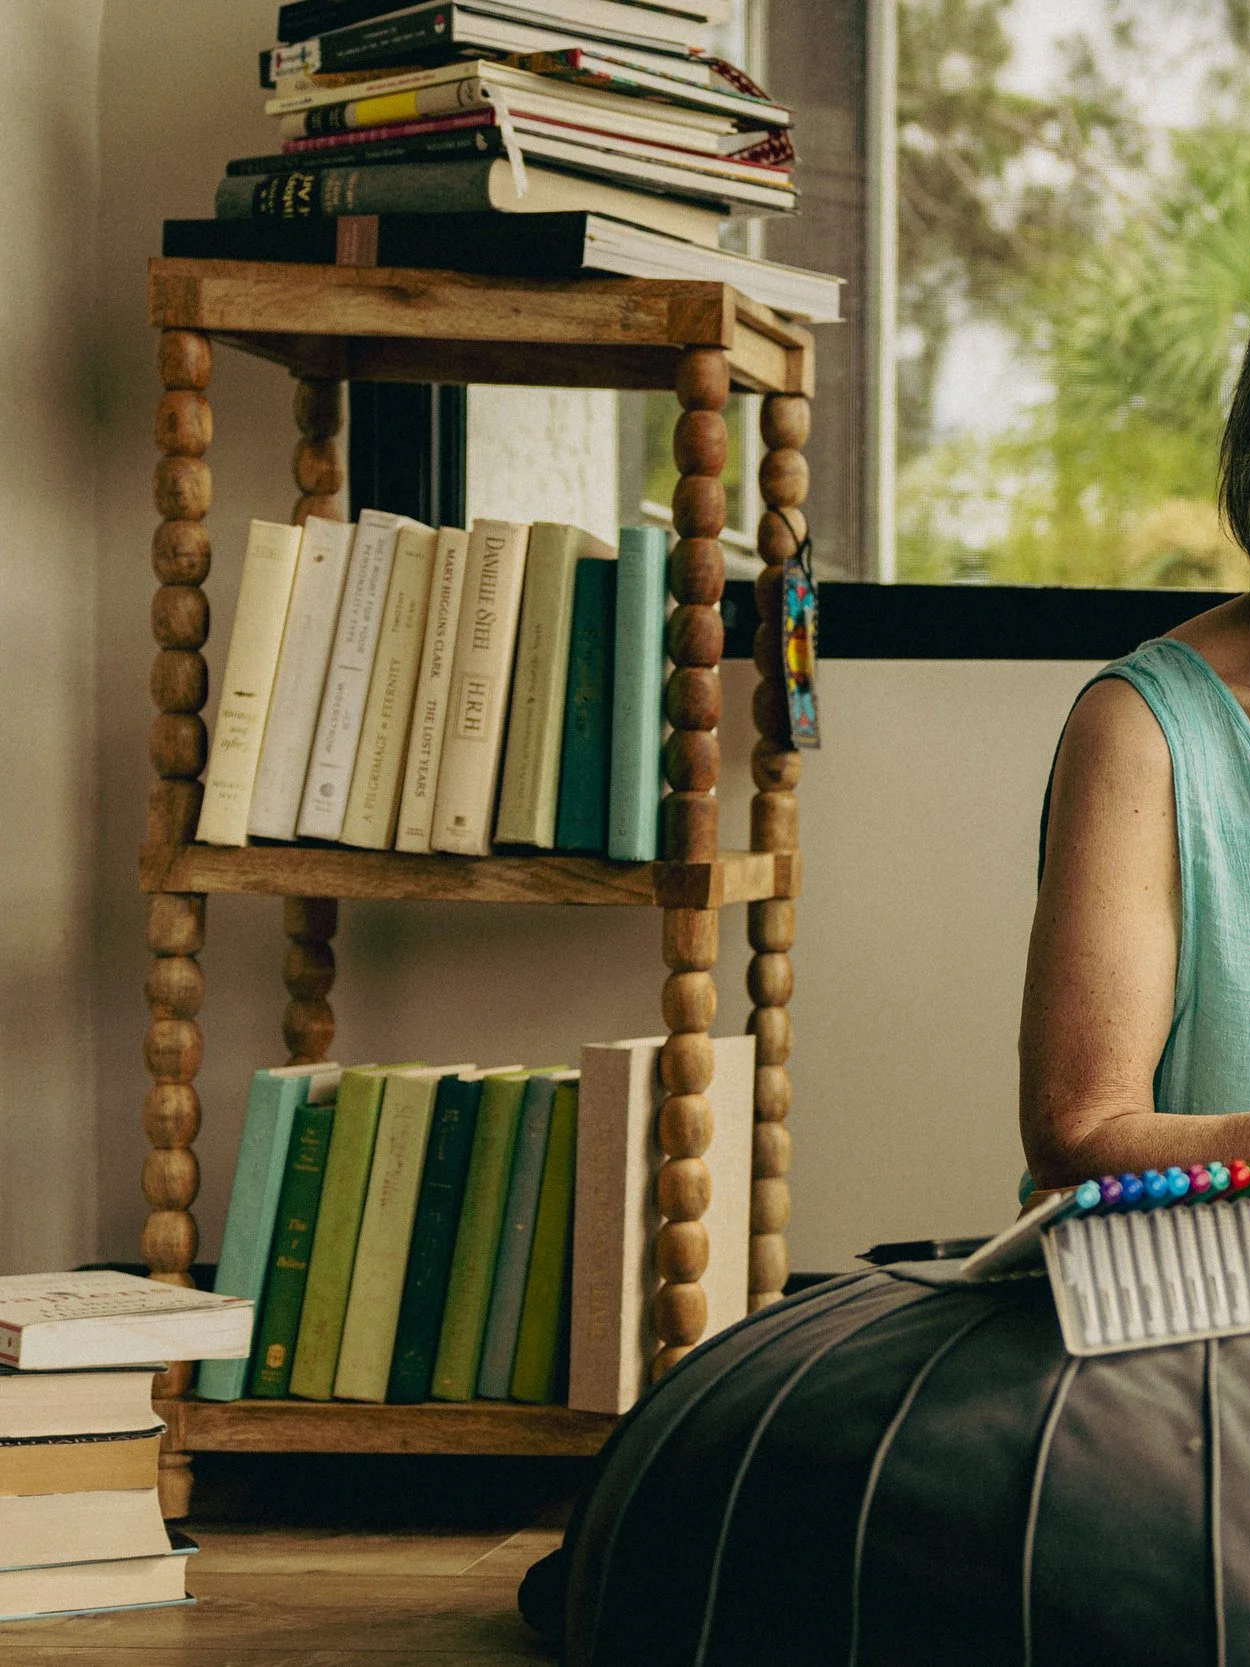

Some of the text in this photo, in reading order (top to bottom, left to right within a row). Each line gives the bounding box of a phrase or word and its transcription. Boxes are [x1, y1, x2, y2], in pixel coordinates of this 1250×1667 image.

[431, 549, 456, 678] MARY HIGGINS CLARK
[472, 537, 505, 651] DANIELLE STEEL
[363, 736, 387, 810] PILGRIMAGE
[381, 658, 400, 718] ETERNITY
[415, 700, 436, 797] THE LOST YEARS
